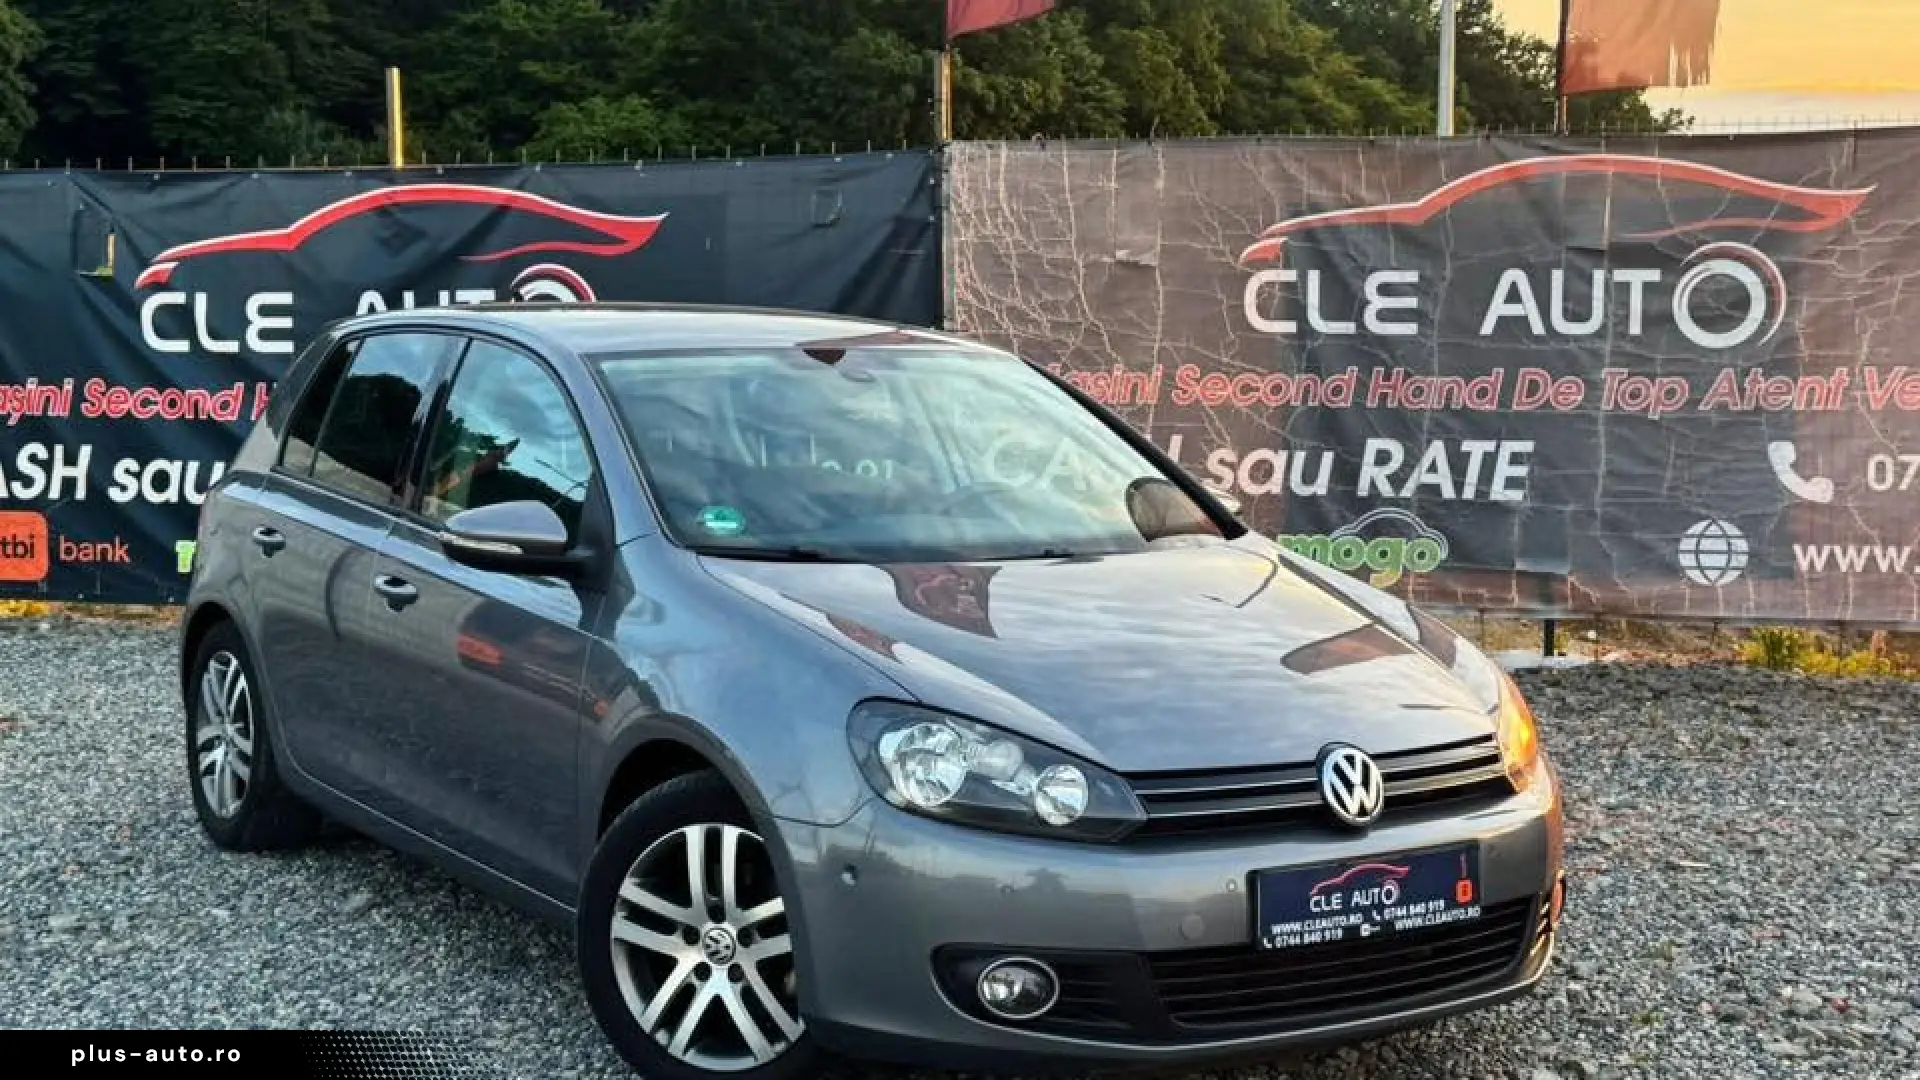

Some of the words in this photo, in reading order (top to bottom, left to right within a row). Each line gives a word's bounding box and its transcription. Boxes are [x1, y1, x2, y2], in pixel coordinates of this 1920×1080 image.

[140, 291, 295, 353] CLE
[1244, 269, 1418, 334] CLE
[1480, 258, 1769, 350] AUTO
[80, 376, 244, 420] Second
[1172, 363, 1358, 408] Second
[1366, 366, 1504, 411] Hand
[1512, 367, 1585, 411] De
[1602, 367, 1690, 420] Top
[1698, 367, 1850, 411] Atent
[0, 441, 92, 501] SH
[1206, 448, 1335, 497] sau
[1356, 440, 1535, 501] RATE
[0, 533, 35, 560] tbi
[59, 534, 131, 564] bank
[1278, 534, 1441, 588] mogo
[1309, 892, 1343, 913] CLE
[1351, 883, 1398, 907] AUTO
